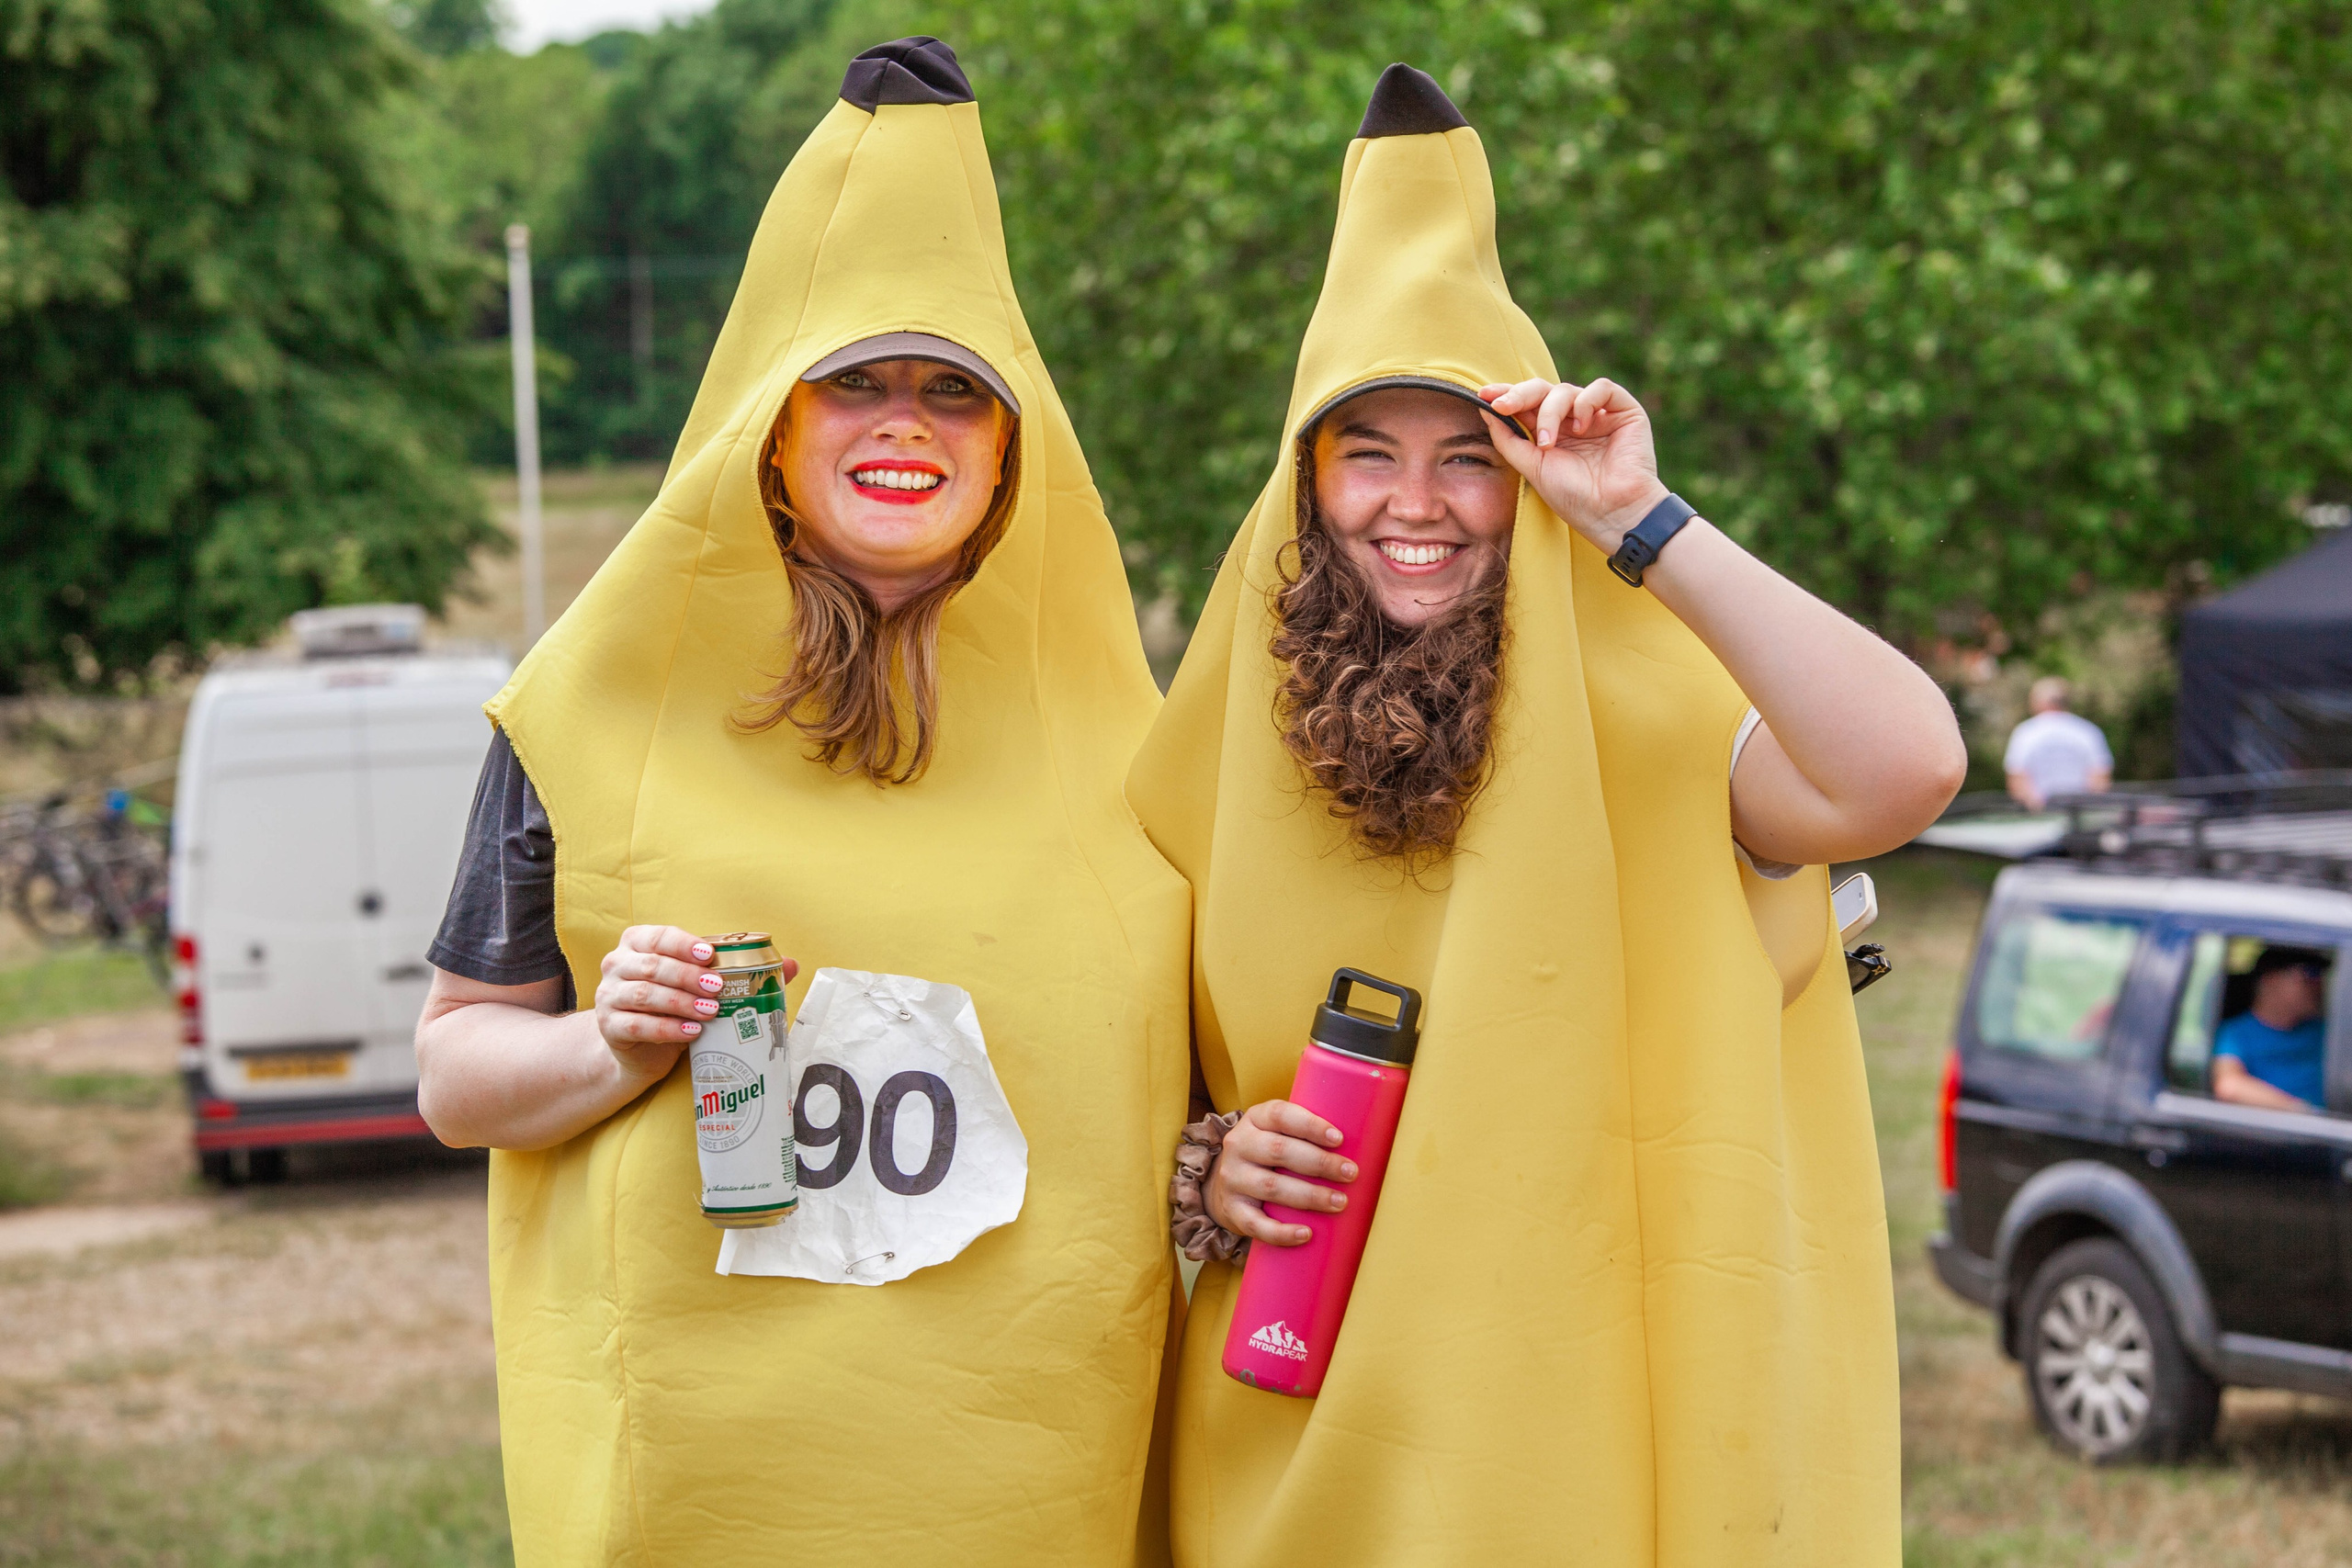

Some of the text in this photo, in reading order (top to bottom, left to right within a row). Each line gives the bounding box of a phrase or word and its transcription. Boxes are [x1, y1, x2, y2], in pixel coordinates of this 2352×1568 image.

[718, 986, 751, 997] SCAPE
[711, 1055, 729, 1065] THE
[729, 1060, 755, 1084] WORLD
[699, 1123, 736, 1132] ESPECIAL
[794, 1063, 957, 1196] 90
[719, 1135, 741, 1149] 1890
[1248, 1337, 1308, 1362] HYDRAPEAK
